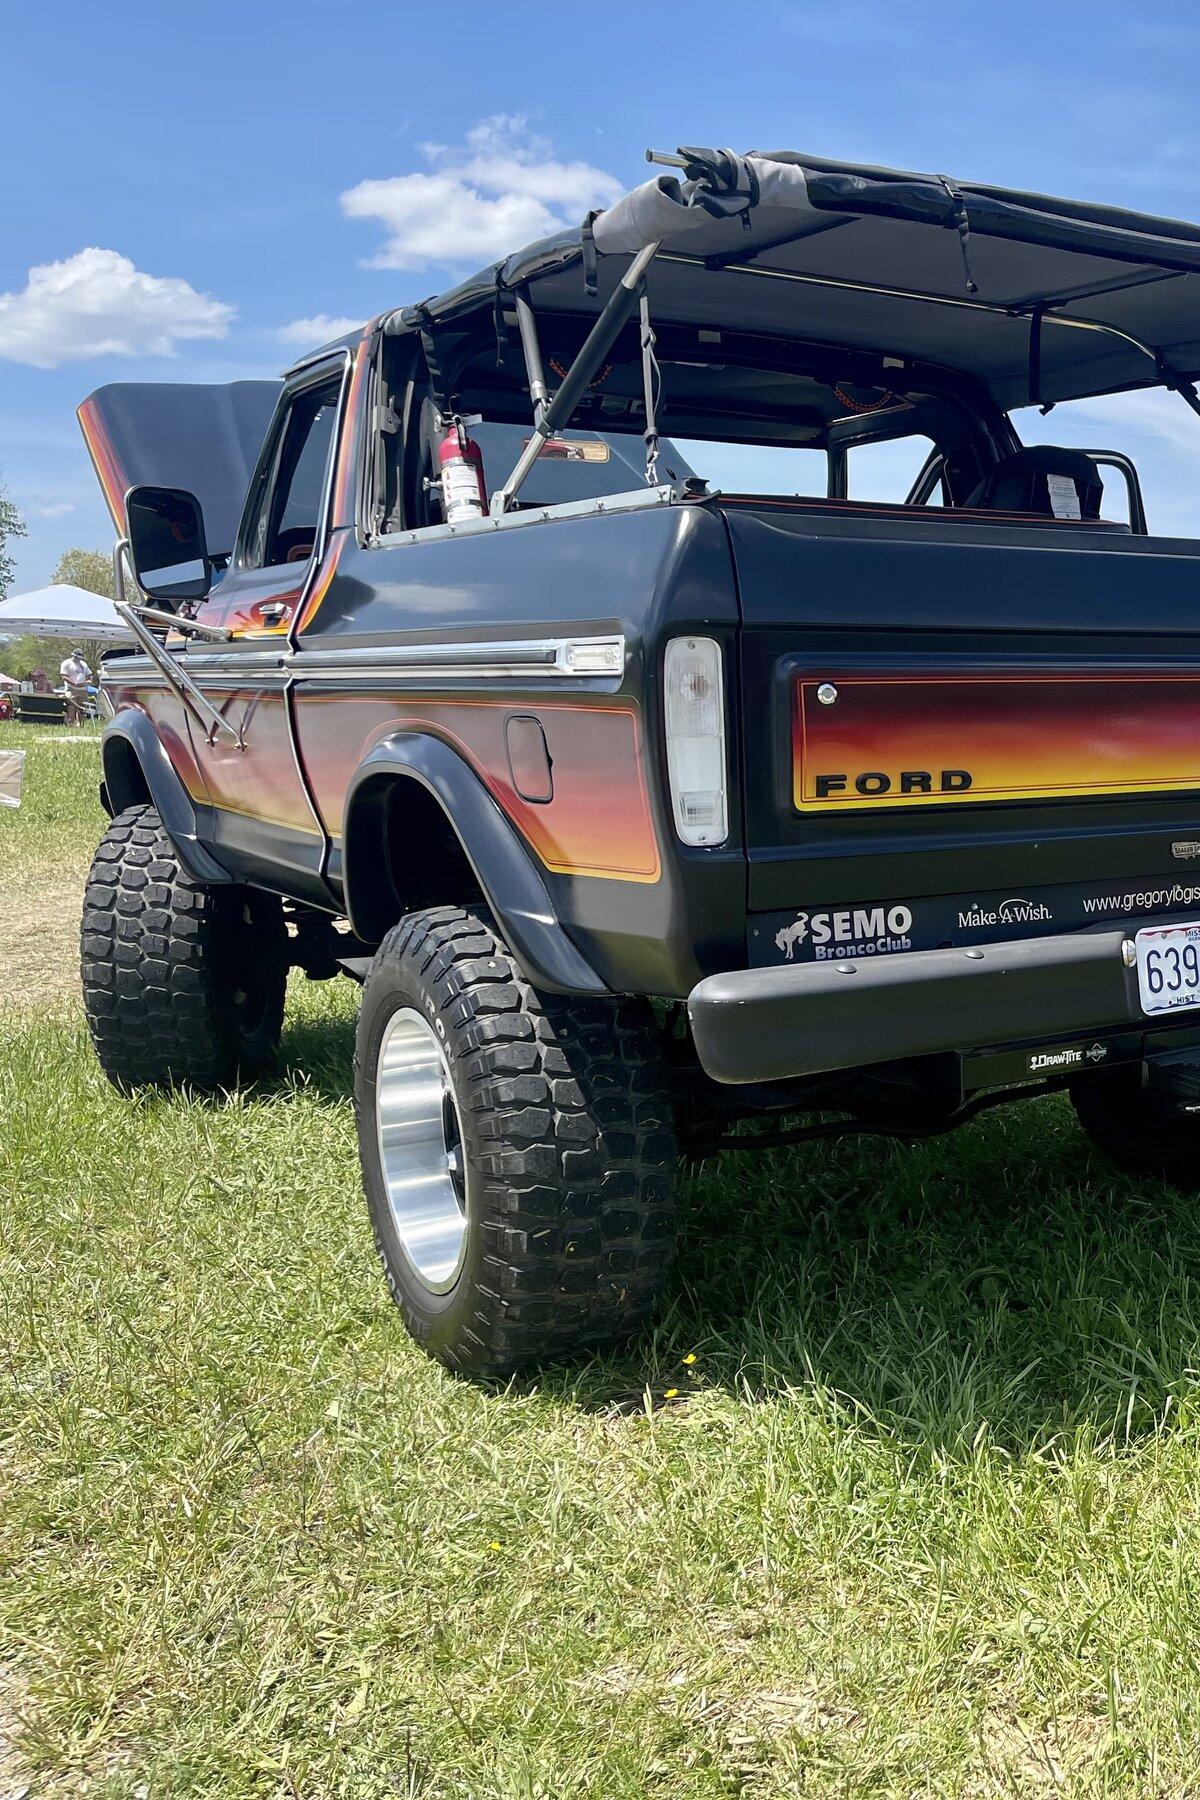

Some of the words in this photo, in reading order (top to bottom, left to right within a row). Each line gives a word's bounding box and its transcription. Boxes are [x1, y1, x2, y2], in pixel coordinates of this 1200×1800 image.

[814, 769, 973, 799] FORD
[810, 905, 913, 944] SEMO
[814, 935, 912, 960] BroncoClub
[1146, 944, 1200, 994] 639
[1176, 993, 1196, 1004] HIST
